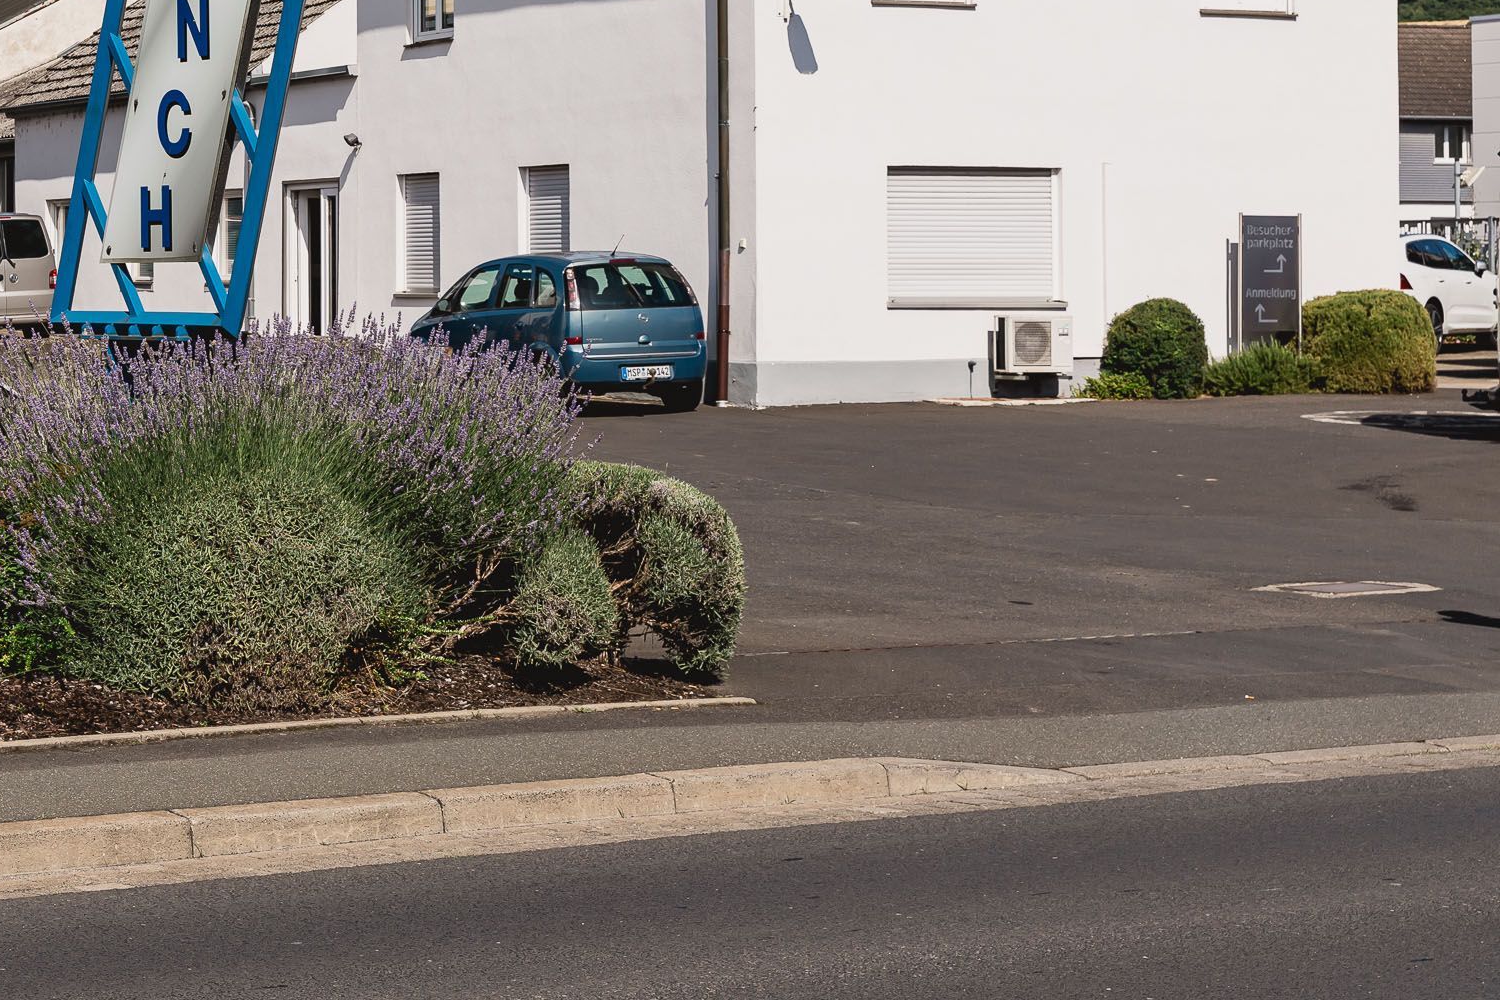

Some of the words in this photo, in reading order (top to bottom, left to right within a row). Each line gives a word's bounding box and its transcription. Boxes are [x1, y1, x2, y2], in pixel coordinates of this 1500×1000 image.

[1247, 224, 1295, 236] Besucher-
[1247, 237, 1294, 250] parkplatz
[1246, 287, 1297, 300] Anmeldung
